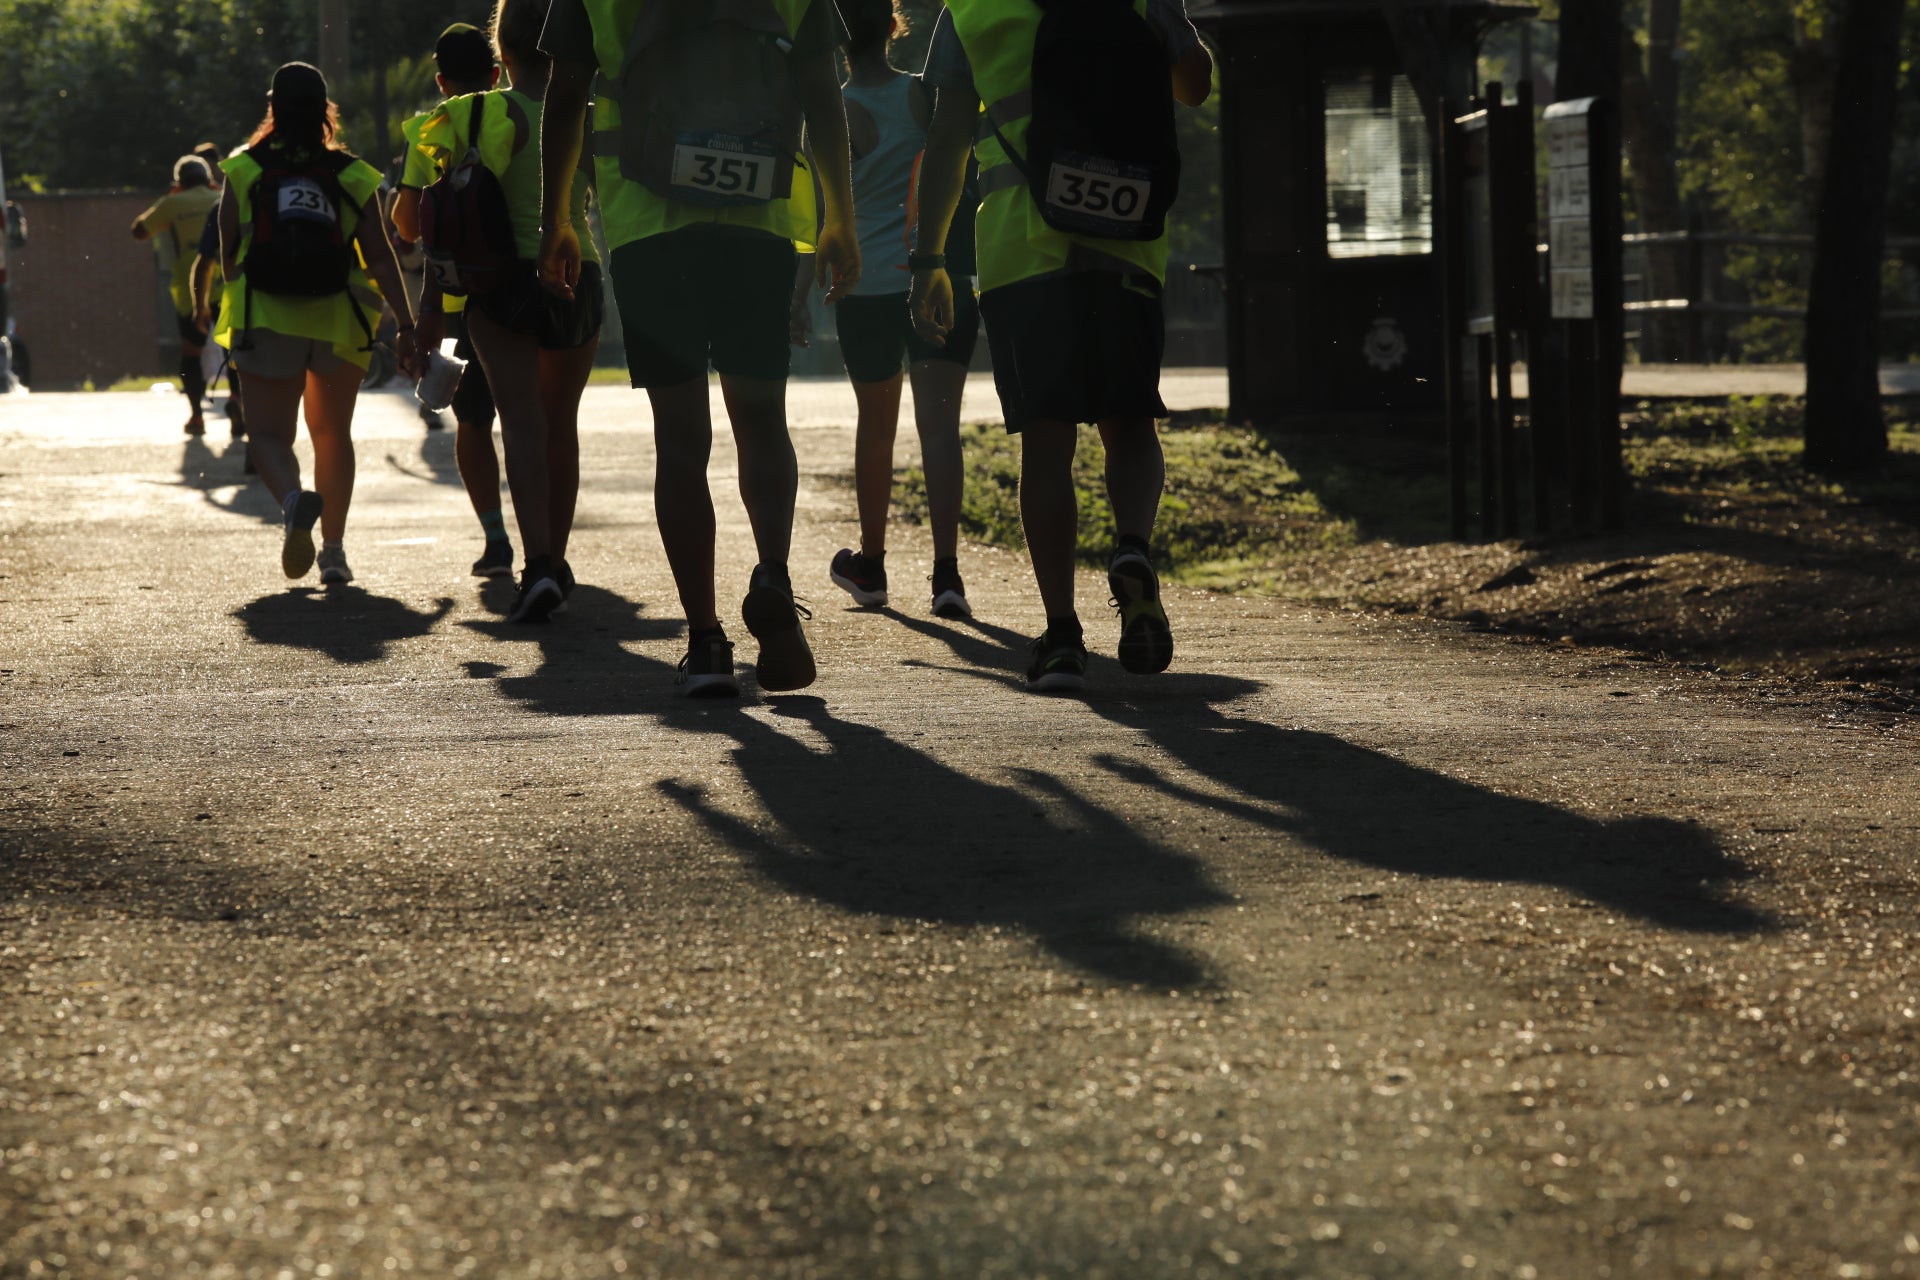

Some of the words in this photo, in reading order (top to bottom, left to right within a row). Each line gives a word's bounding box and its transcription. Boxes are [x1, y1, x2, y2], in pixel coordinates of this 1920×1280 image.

[689, 154, 759, 192] 351
[289, 189, 328, 212] 231
[1057, 173, 1138, 216] 350
